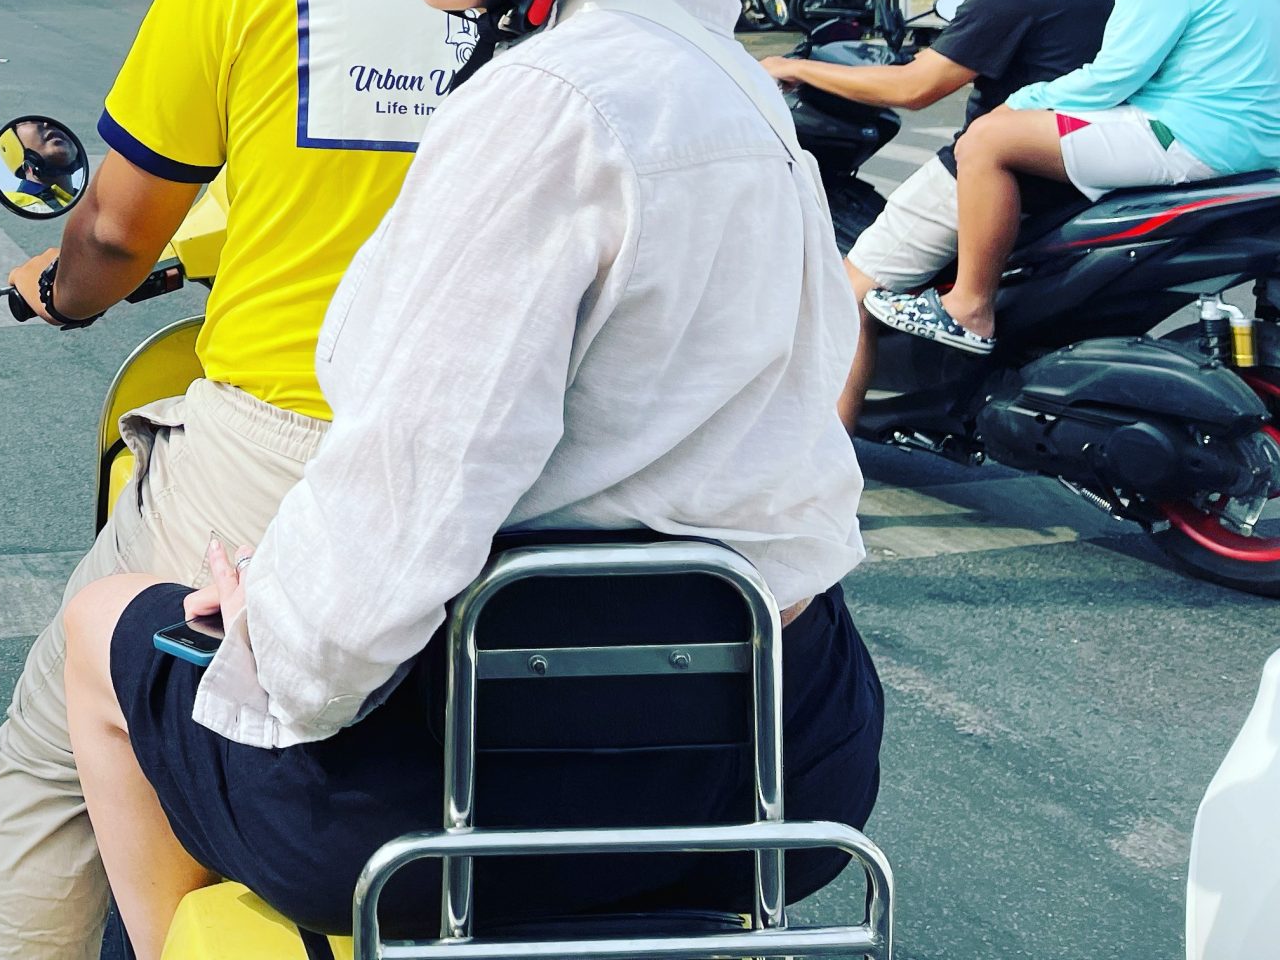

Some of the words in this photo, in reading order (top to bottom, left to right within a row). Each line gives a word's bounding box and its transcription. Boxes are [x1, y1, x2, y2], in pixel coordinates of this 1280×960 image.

[349, 65, 425, 92] Urban
[376, 101, 408, 114] Life
[886, 315, 936, 339] crocs
